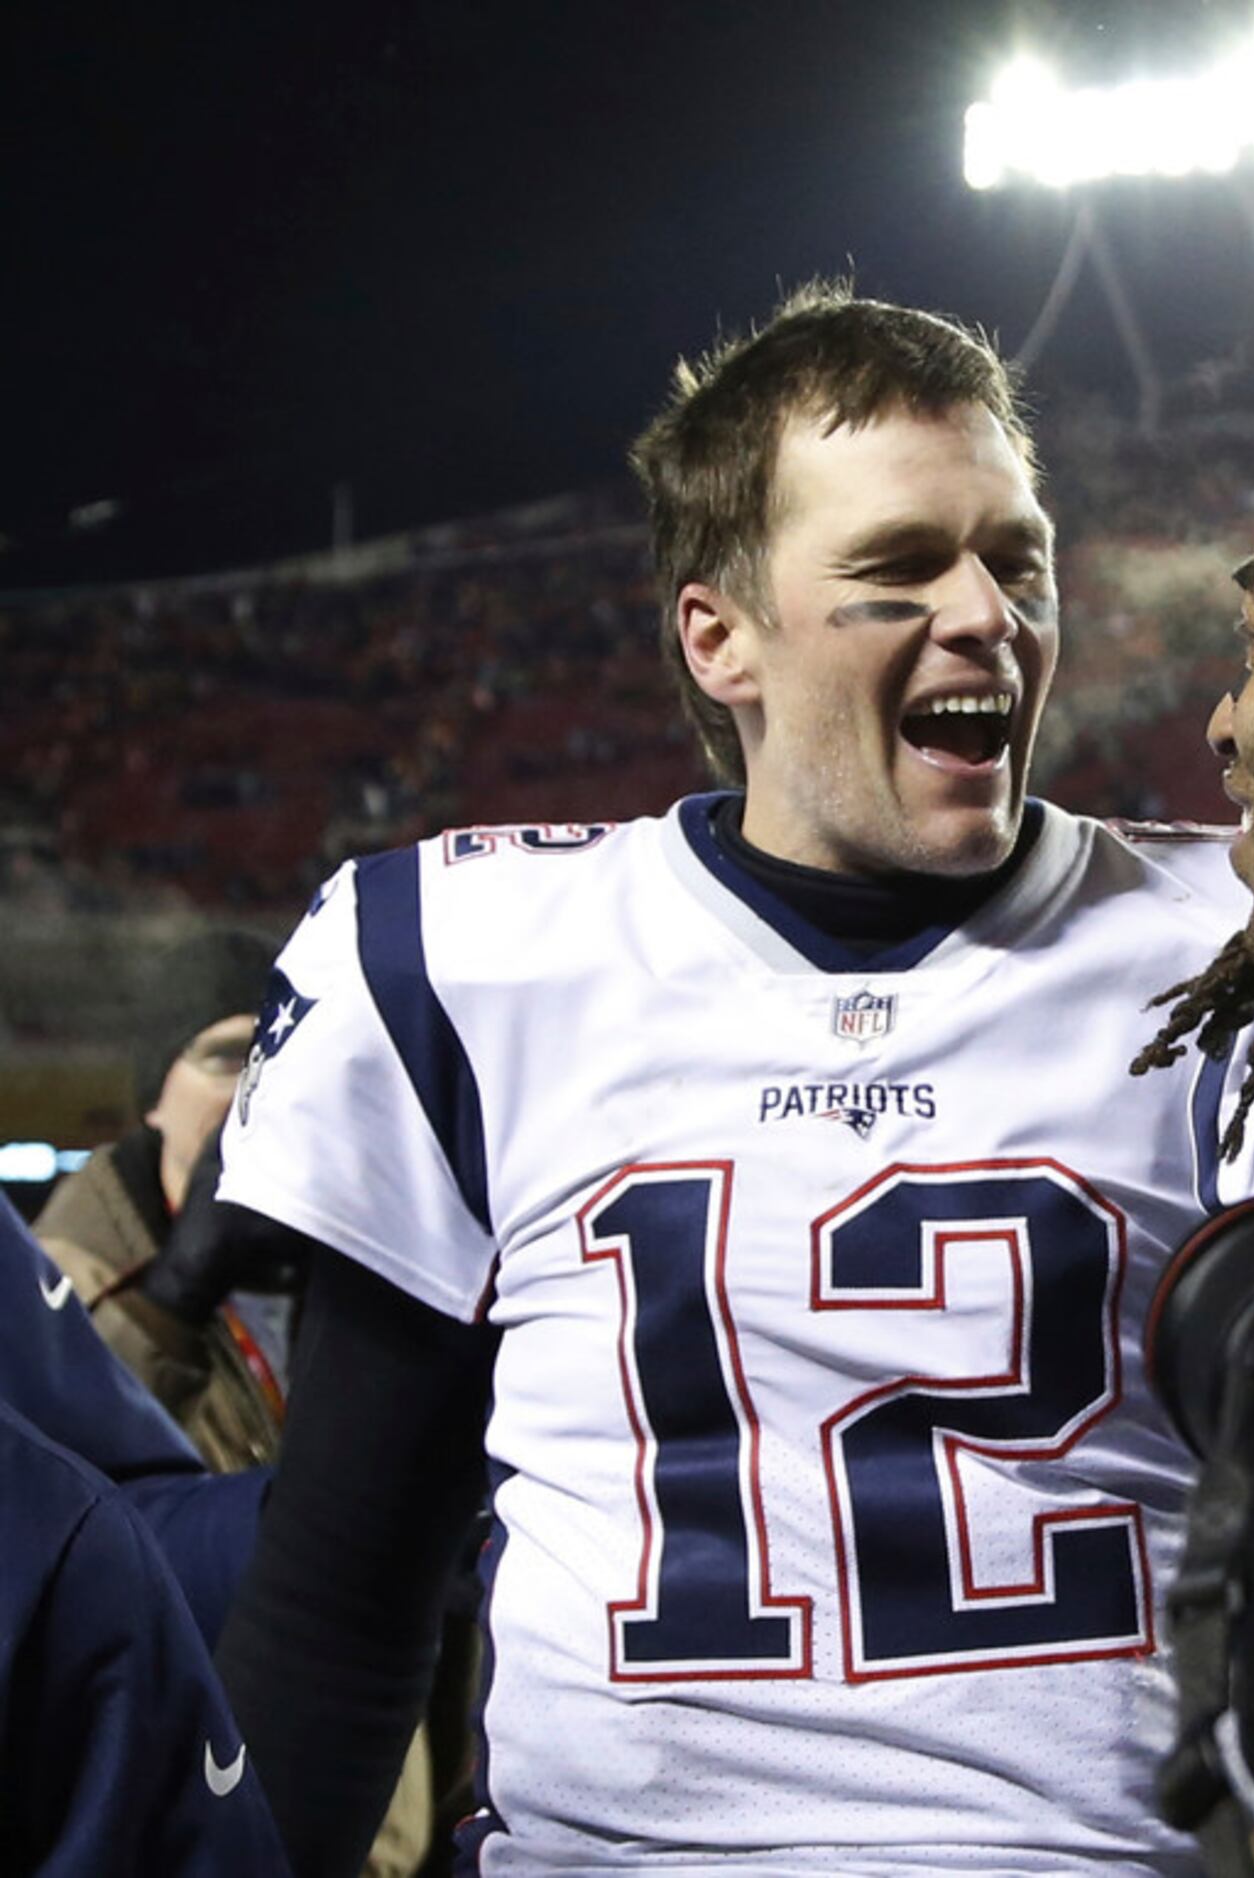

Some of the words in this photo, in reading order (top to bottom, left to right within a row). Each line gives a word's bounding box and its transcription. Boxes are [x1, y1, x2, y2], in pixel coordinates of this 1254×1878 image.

[840, 1012, 884, 1035] NFL
[758, 1083, 937, 1123] PATRIOTS
[576, 1157, 1157, 1684] 12
